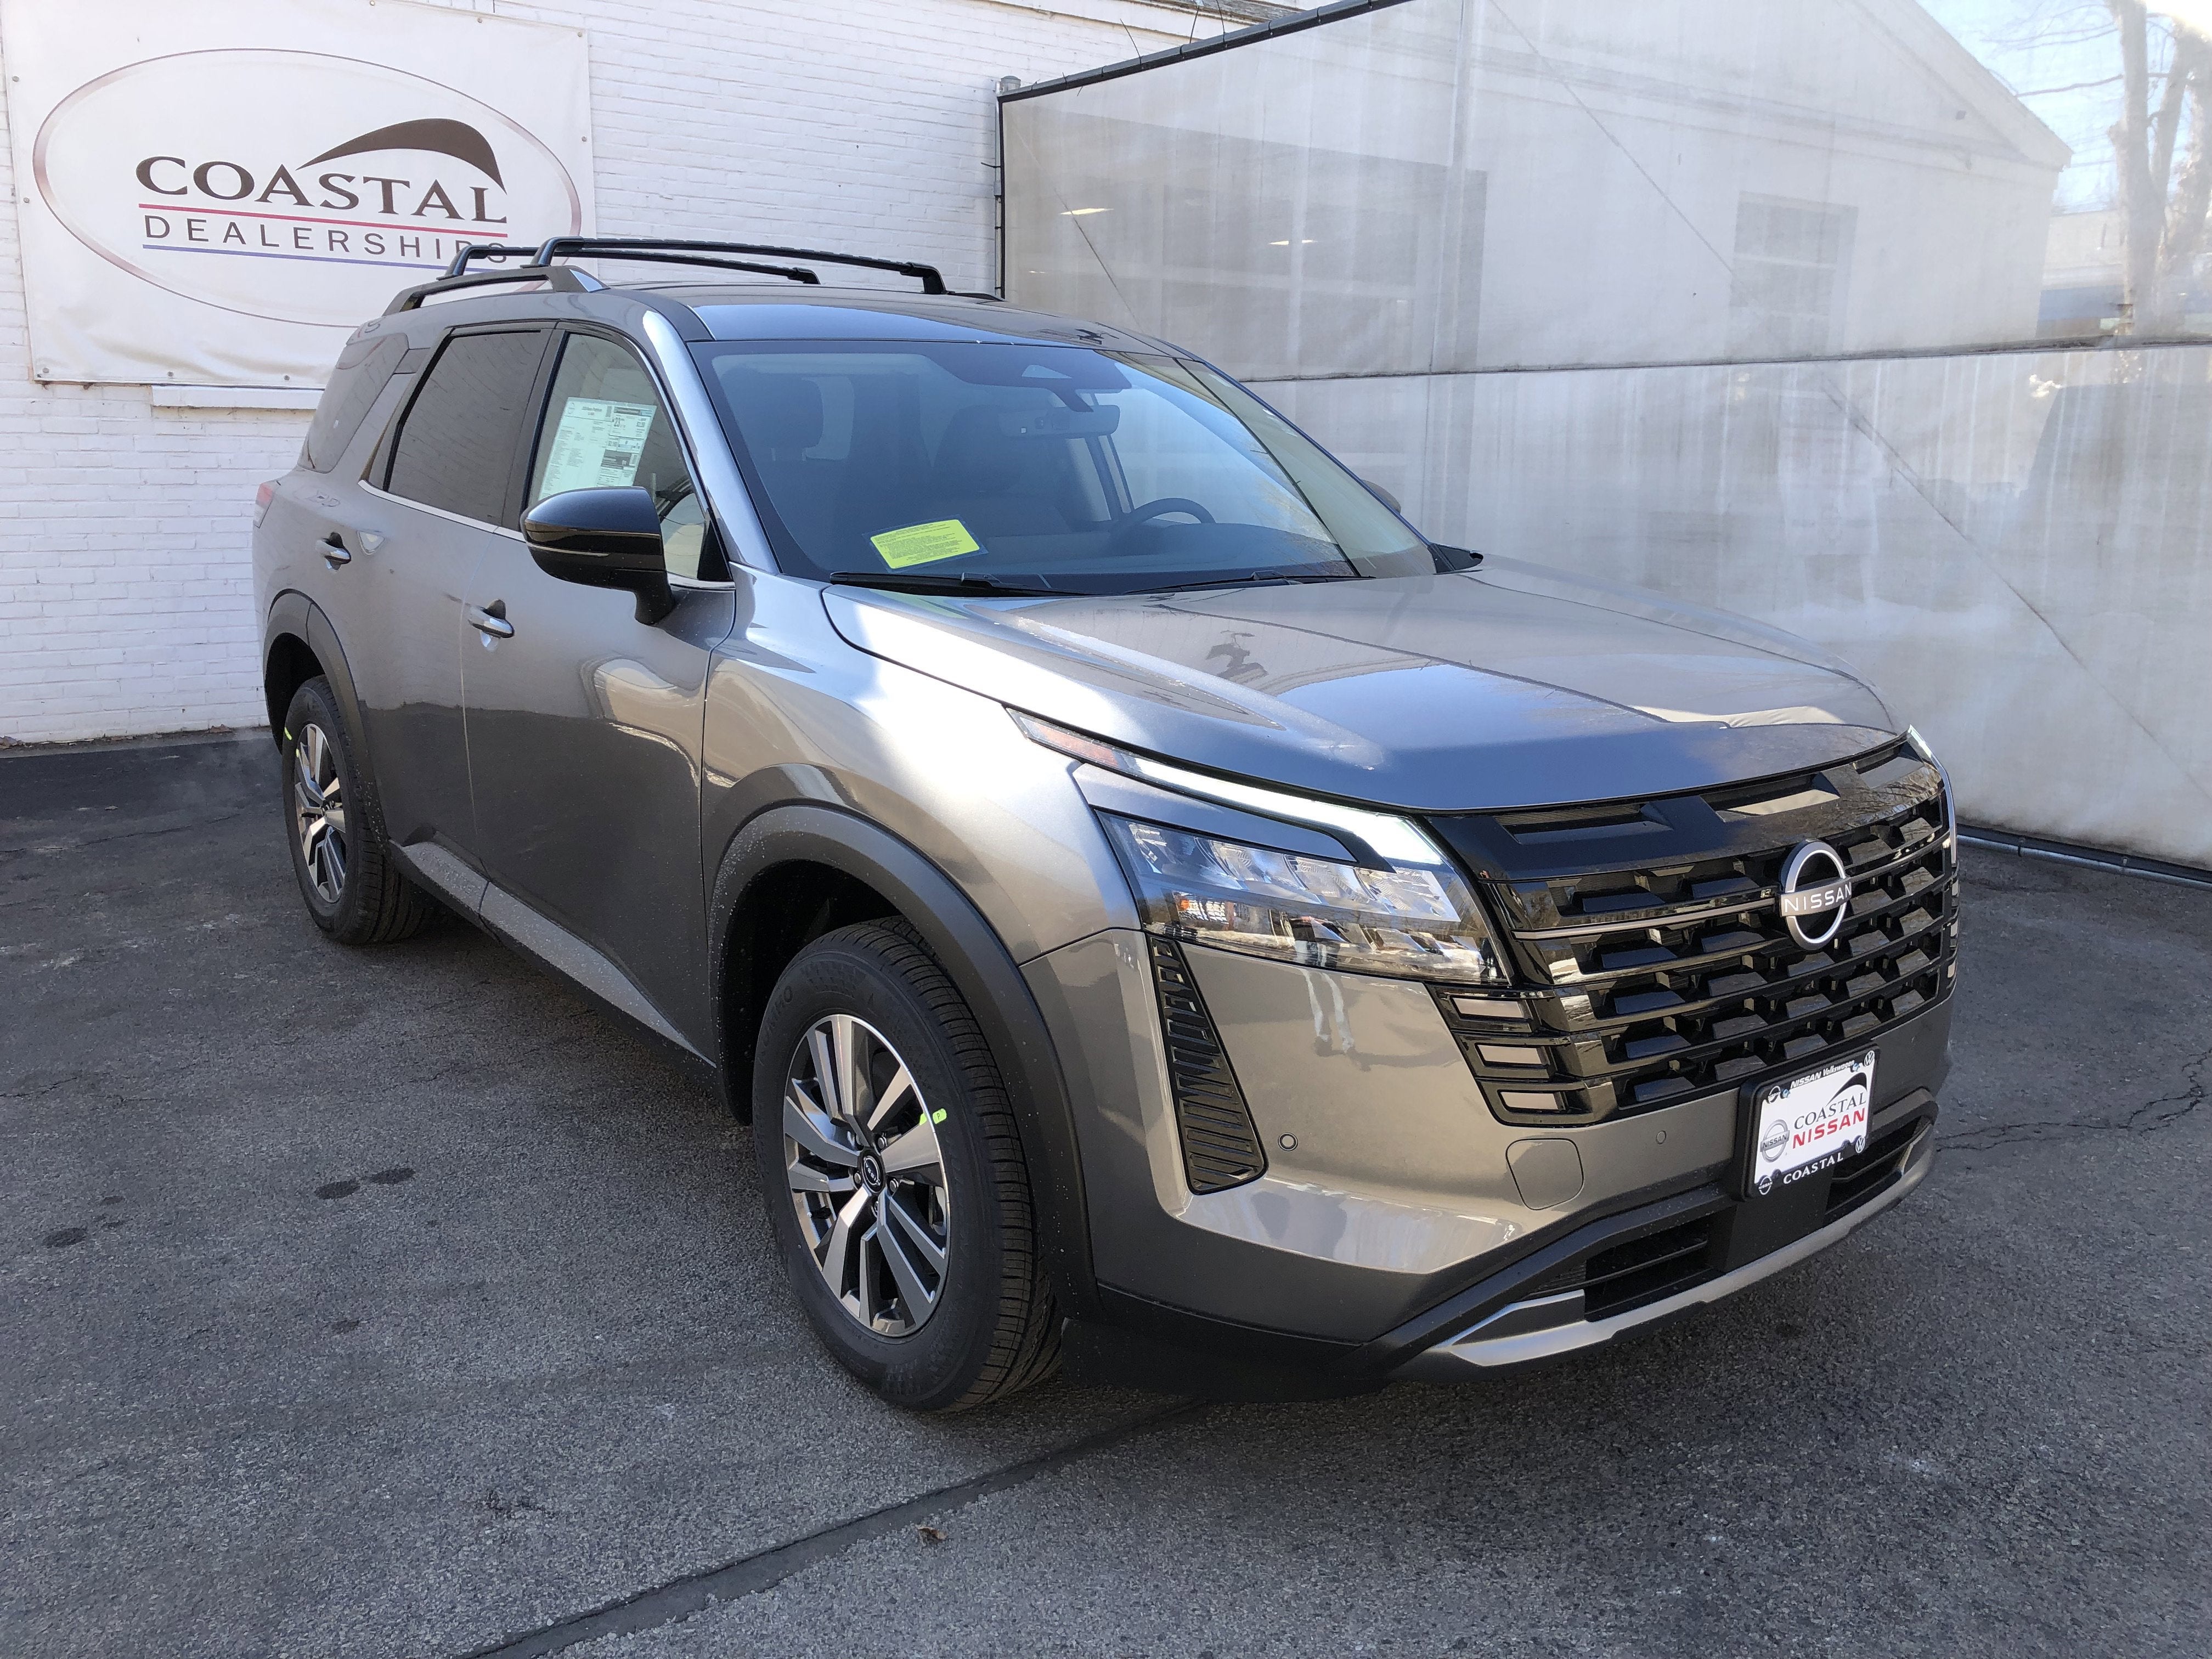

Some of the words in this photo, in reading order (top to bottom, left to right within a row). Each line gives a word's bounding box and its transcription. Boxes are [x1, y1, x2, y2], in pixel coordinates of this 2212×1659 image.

[136, 156, 507, 223] COASTAL
[1784, 881, 1852, 913] NISSAN
[1790, 1071, 1822, 1089] NISSAN
[1822, 1059, 1855, 1076] Volkswagen
[1794, 1092, 1867, 1130] COASTAL
[1762, 1133, 1787, 1149] NISSAN
[1792, 1107, 1865, 1149] NISSAN
[1783, 1152, 1844, 1184] COASTAL
